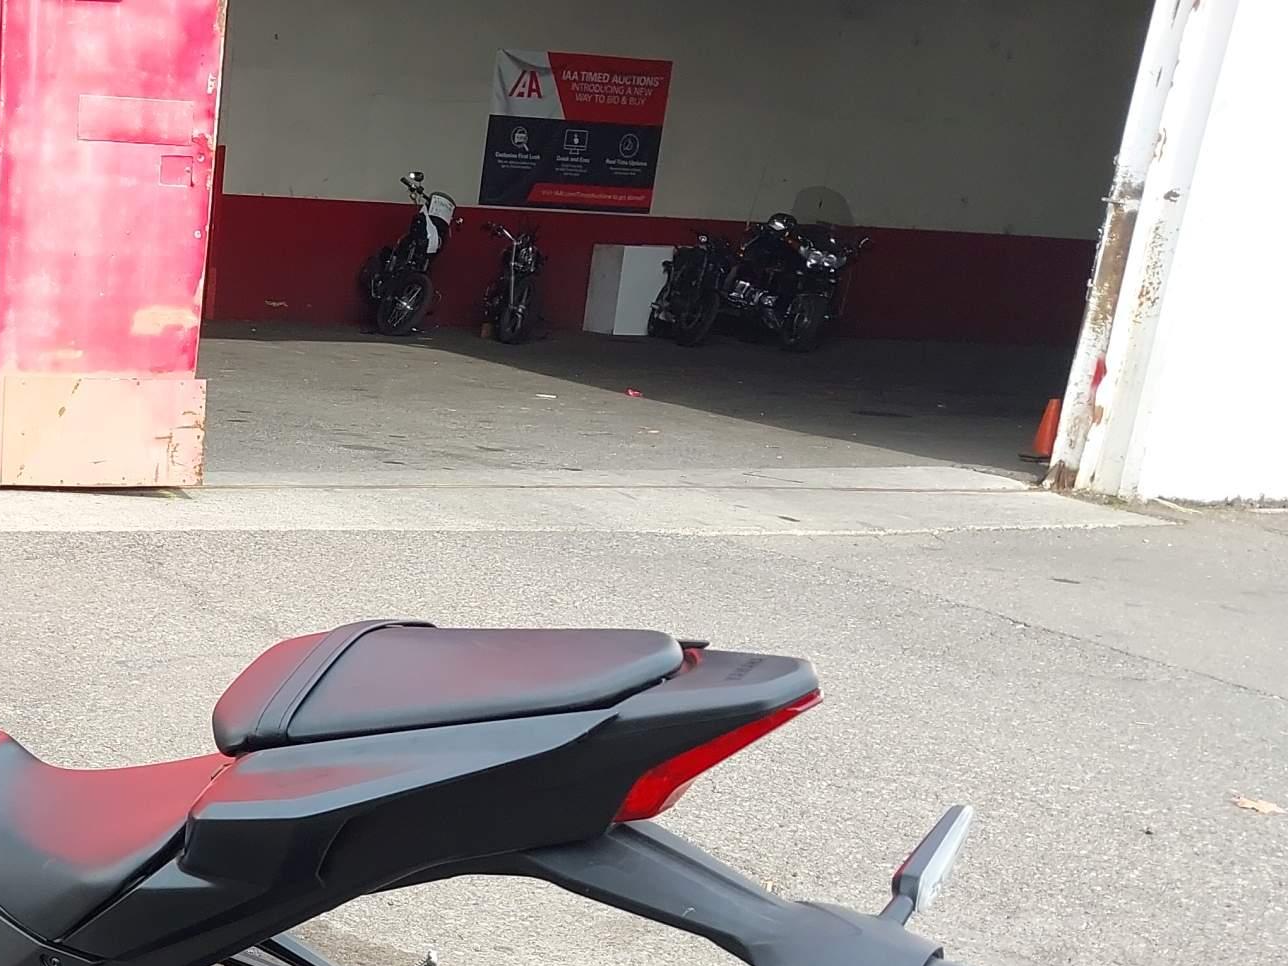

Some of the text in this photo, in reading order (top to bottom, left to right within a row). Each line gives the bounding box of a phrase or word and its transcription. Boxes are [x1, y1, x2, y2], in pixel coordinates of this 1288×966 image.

[562, 70, 579, 81] IAA
[580, 71, 610, 83] TIMED
[571, 82, 653, 96] INTRODUCING A NEW
[575, 93, 593, 102] WAY
[594, 94, 606, 103] TO
[606, 95, 620, 104] BID
[628, 97, 647, 106] BUY
